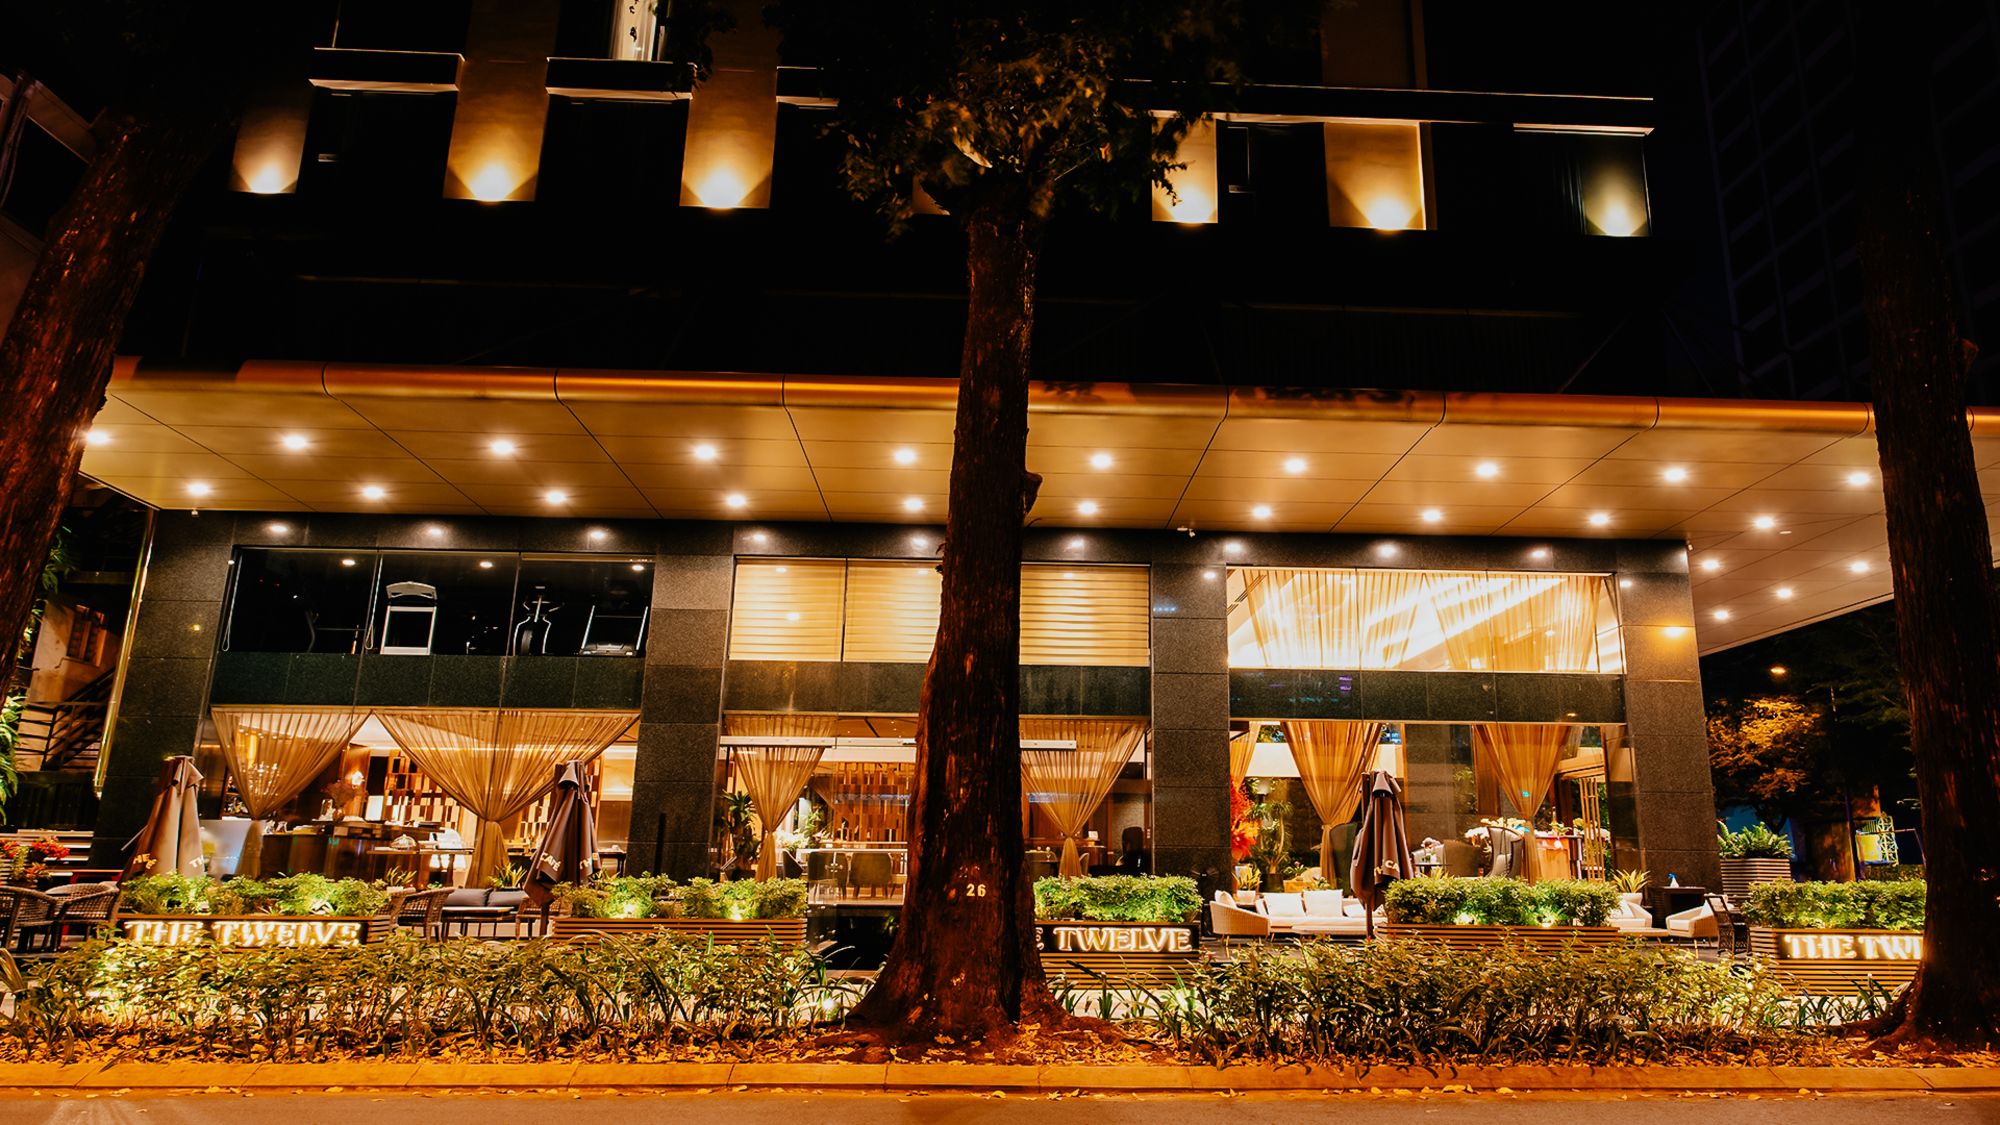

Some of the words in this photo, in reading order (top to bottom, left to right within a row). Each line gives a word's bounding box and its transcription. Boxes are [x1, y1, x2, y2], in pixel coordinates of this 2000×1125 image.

[966, 883, 986, 897] 26
[124, 921, 204, 946] THE
[211, 921, 362, 947] TWELVE
[1053, 927, 1193, 952] TWELVE
[1784, 934, 1857, 959] THE
